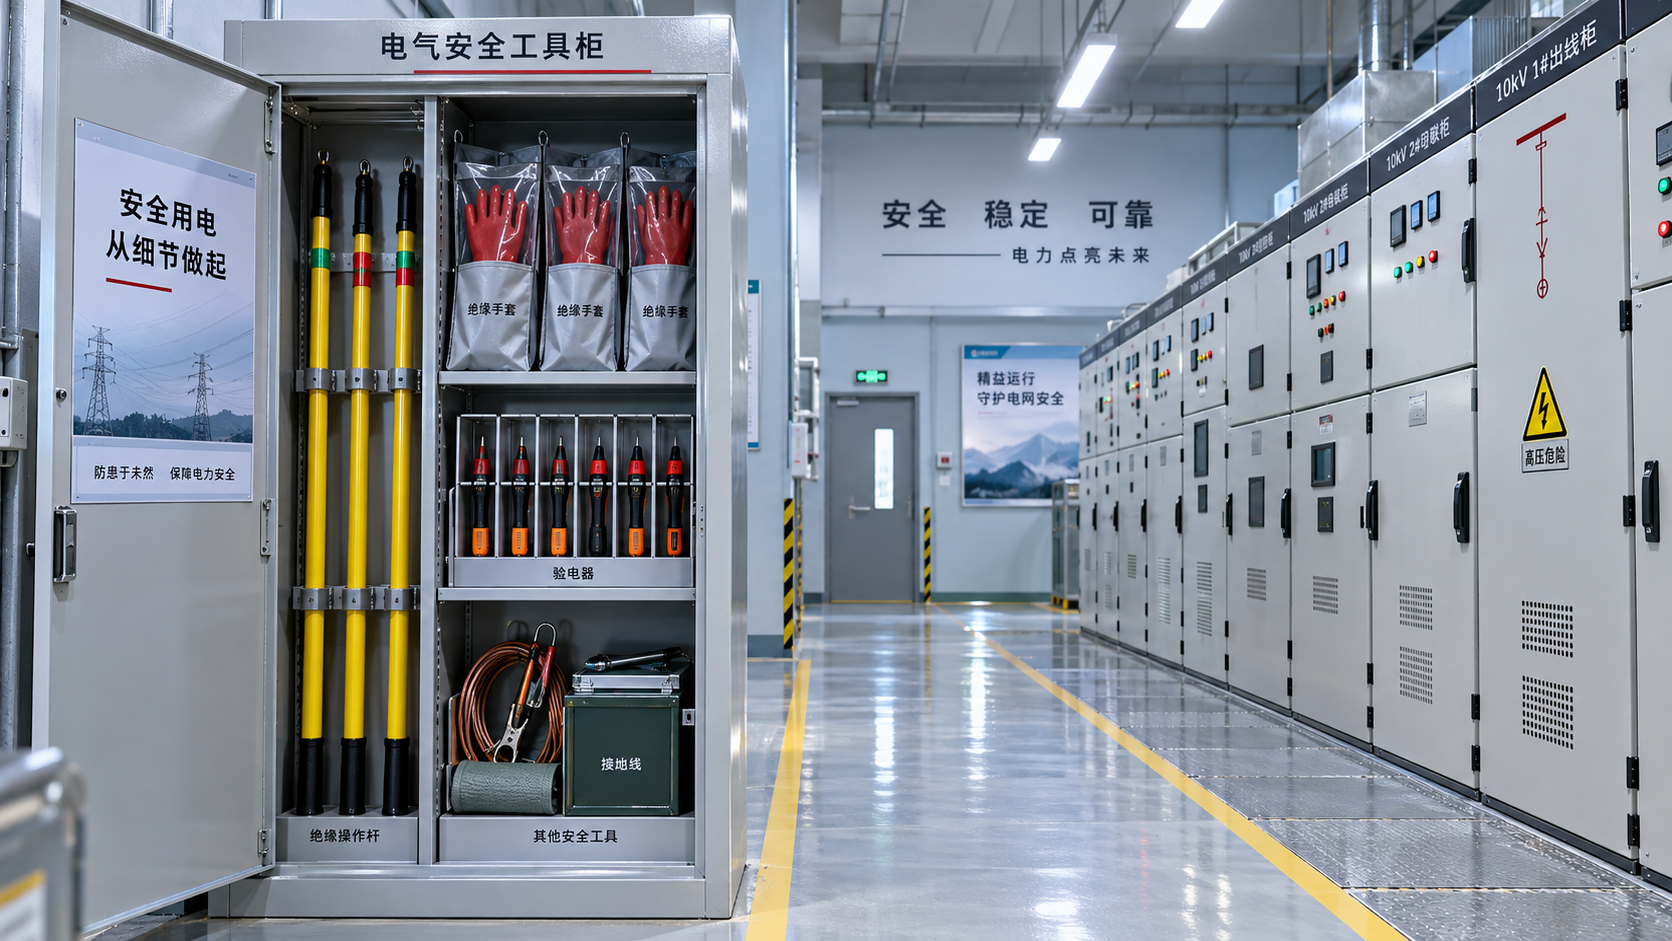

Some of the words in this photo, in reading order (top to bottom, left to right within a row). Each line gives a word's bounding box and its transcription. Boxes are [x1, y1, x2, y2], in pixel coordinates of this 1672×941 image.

[380, 31, 604, 61] 电气安全工具柜
[1496, 66, 1528, 102] 10kV
[1532, 19, 1597, 80] 1#出线柜
[1386, 145, 1407, 171] 10kV
[119, 188, 217, 238] 安全用电
[882, 199, 947, 229] 安全
[984, 199, 1049, 229] 稳定
[1088, 199, 1153, 230] 可靠
[106, 229, 227, 281] 从细节做起
[1012, 246, 1150, 264] 电力点亮未来
[467, 301, 517, 317] 绝缘手套
[557, 303, 604, 317] 绝缘手套
[977, 371, 1035, 386] 精益运行
[977, 391, 1064, 406] 守护电网安全
[1525, 446, 1566, 467] 高压危险
[94, 464, 154, 480] 防患于未然
[169, 466, 236, 481] 保障电力安全
[552, 566, 594, 581] 验电器
[601, 756, 642, 771] 接地线
[309, 828, 380, 843] 绝缘操作杆
[533, 829, 618, 844] 其他安全工具
